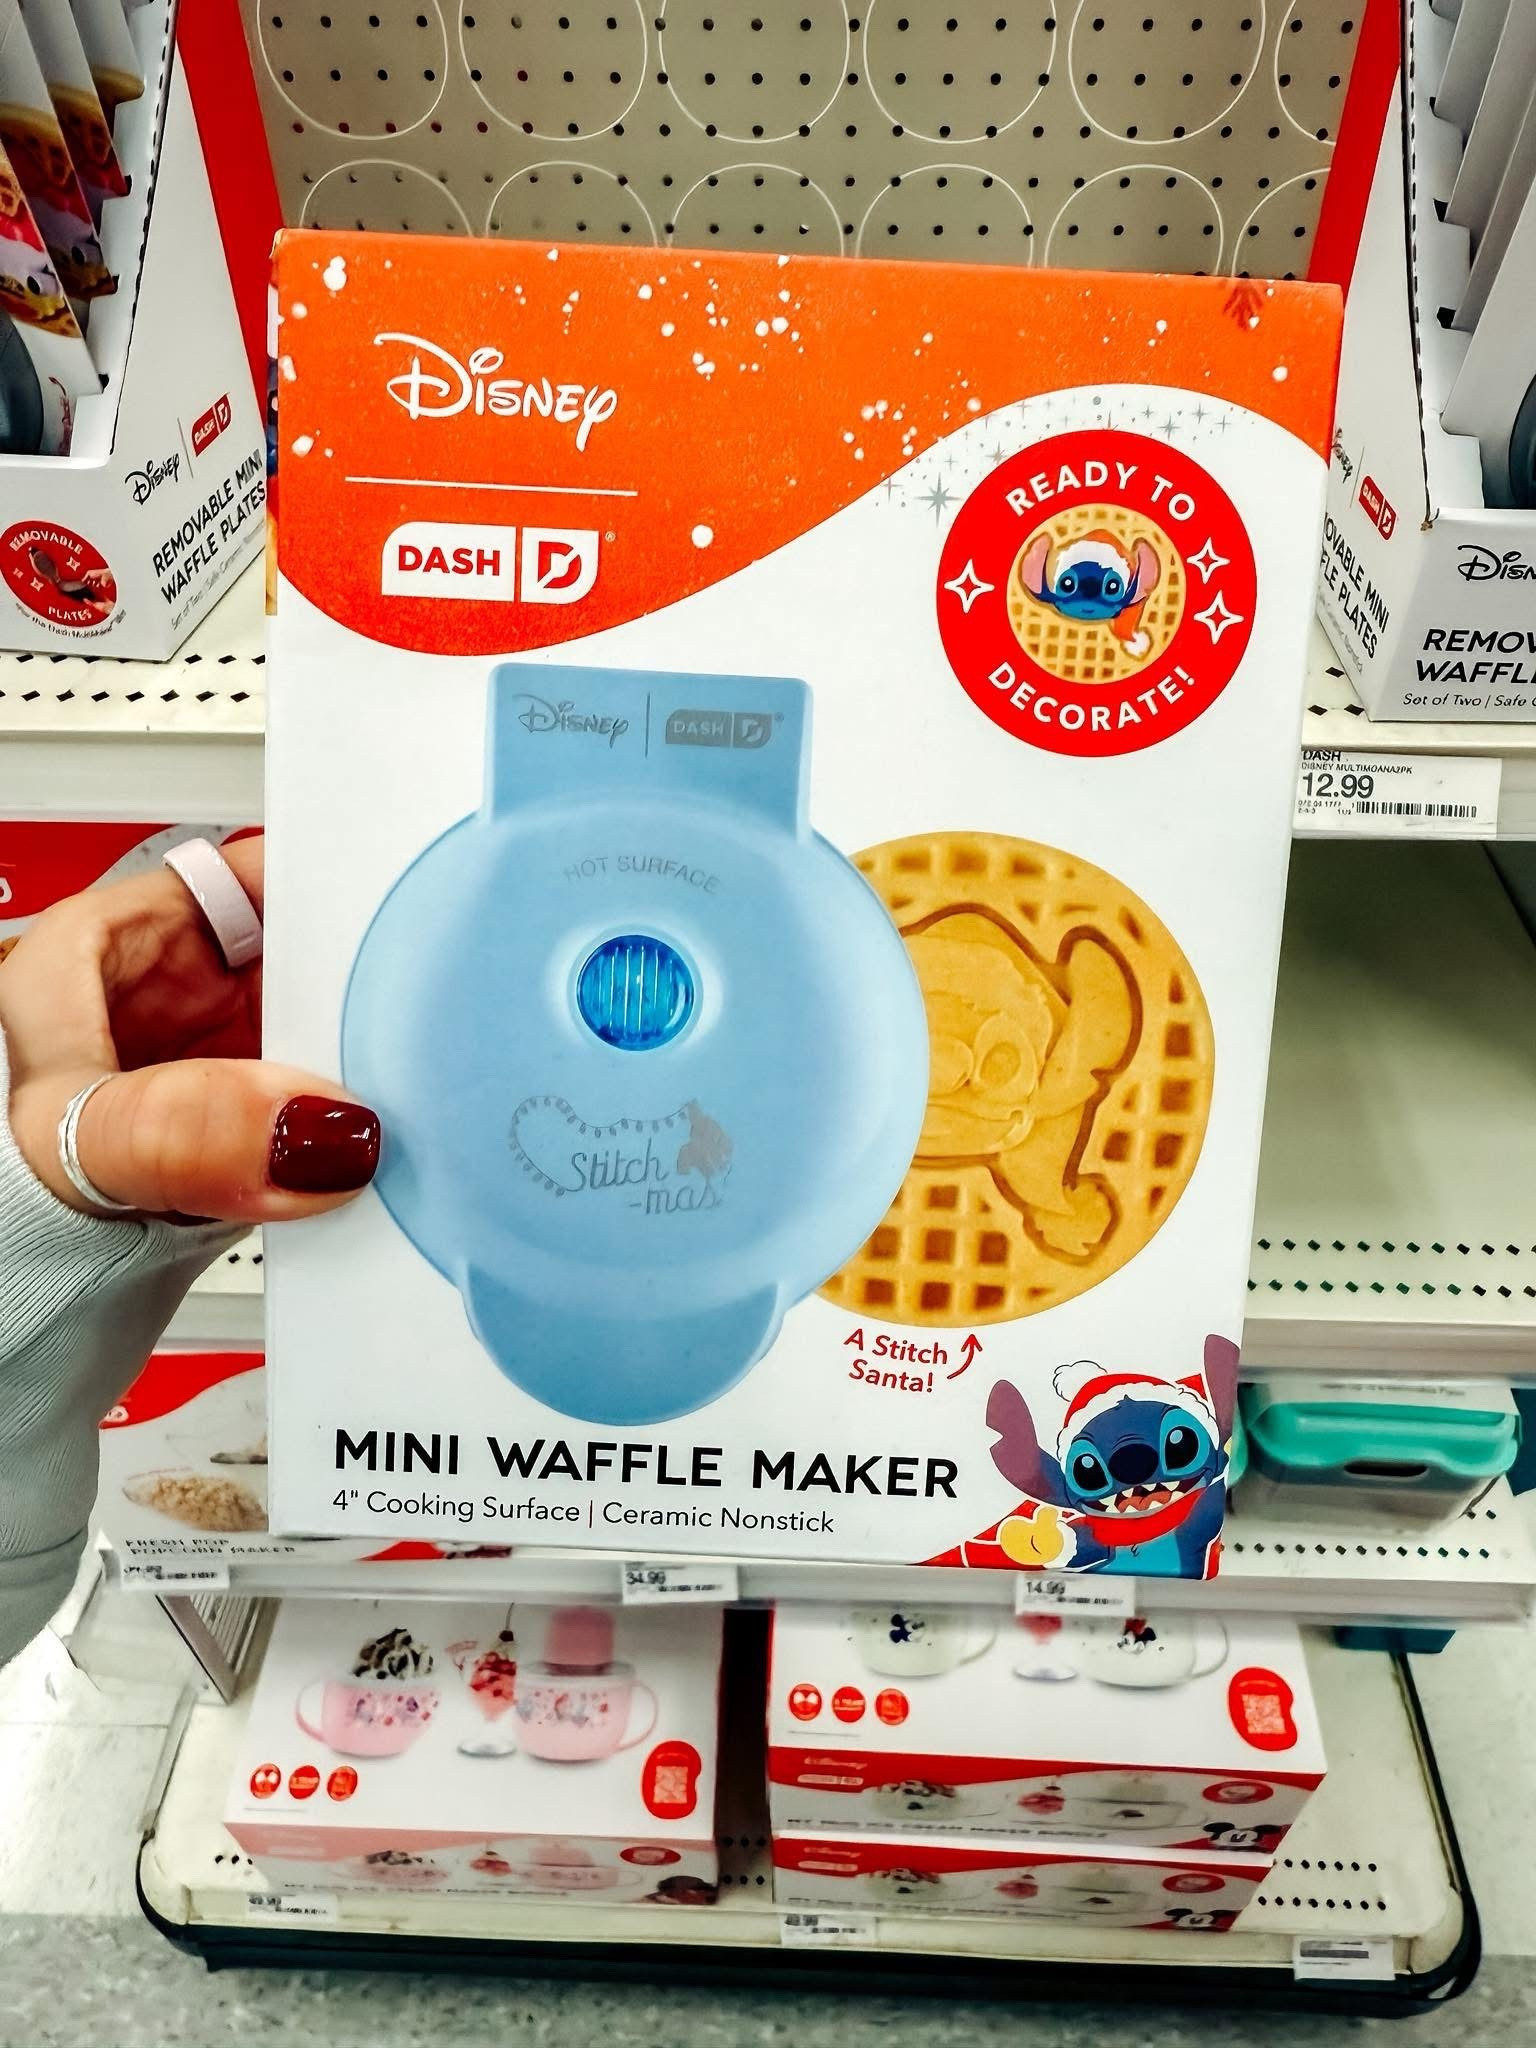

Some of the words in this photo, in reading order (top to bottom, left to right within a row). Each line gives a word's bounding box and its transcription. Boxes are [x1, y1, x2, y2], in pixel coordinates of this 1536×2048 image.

[373, 332, 618, 452] Disney
[125, 452, 180, 505] Disney
[1005, 461, 1138, 517] READY
[1150, 474, 1195, 521] TO
[153, 478, 234, 577] REMOVABLE
[235, 449, 263, 489] MINI
[161, 532, 219, 604] WAFFLE
[220, 480, 265, 542] PLATES
[398, 544, 500, 576] DASH
[1325, 512, 1364, 591] OVABLE
[1365, 580, 1389, 633] MINI
[1338, 581, 1377, 658] PLATES
[512, 693, 629, 749] Disney
[674, 720, 725, 736] DASH
[988, 661, 1194, 731] DECORATE!
[1432, 692, 1449, 705] of
[1453, 694, 1481, 706] Two
[1494, 694, 1526, 707] Safe
[1303, 750, 1341, 762] DASH
[1302, 772, 1374, 798] 12.99
[565, 856, 609, 882] HOT
[617, 855, 720, 894] SURFACE
[568, 1137, 669, 1192] Stitch
[843, 1328, 864, 1350] A
[872, 1335, 948, 1364] Stitch
[849, 1359, 933, 1392] Santa!
[335, 1428, 458, 1474] MINI
[487, 1436, 723, 1487] WAFFLE
[752, 1449, 958, 1498] MAKER
[333, 1488, 358, 1511] 4"
[367, 1490, 474, 1522] Cooking
[483, 1496, 580, 1521] Surface
[603, 1502, 712, 1528] Ceramic
[721, 1507, 835, 1533] Nonstick
